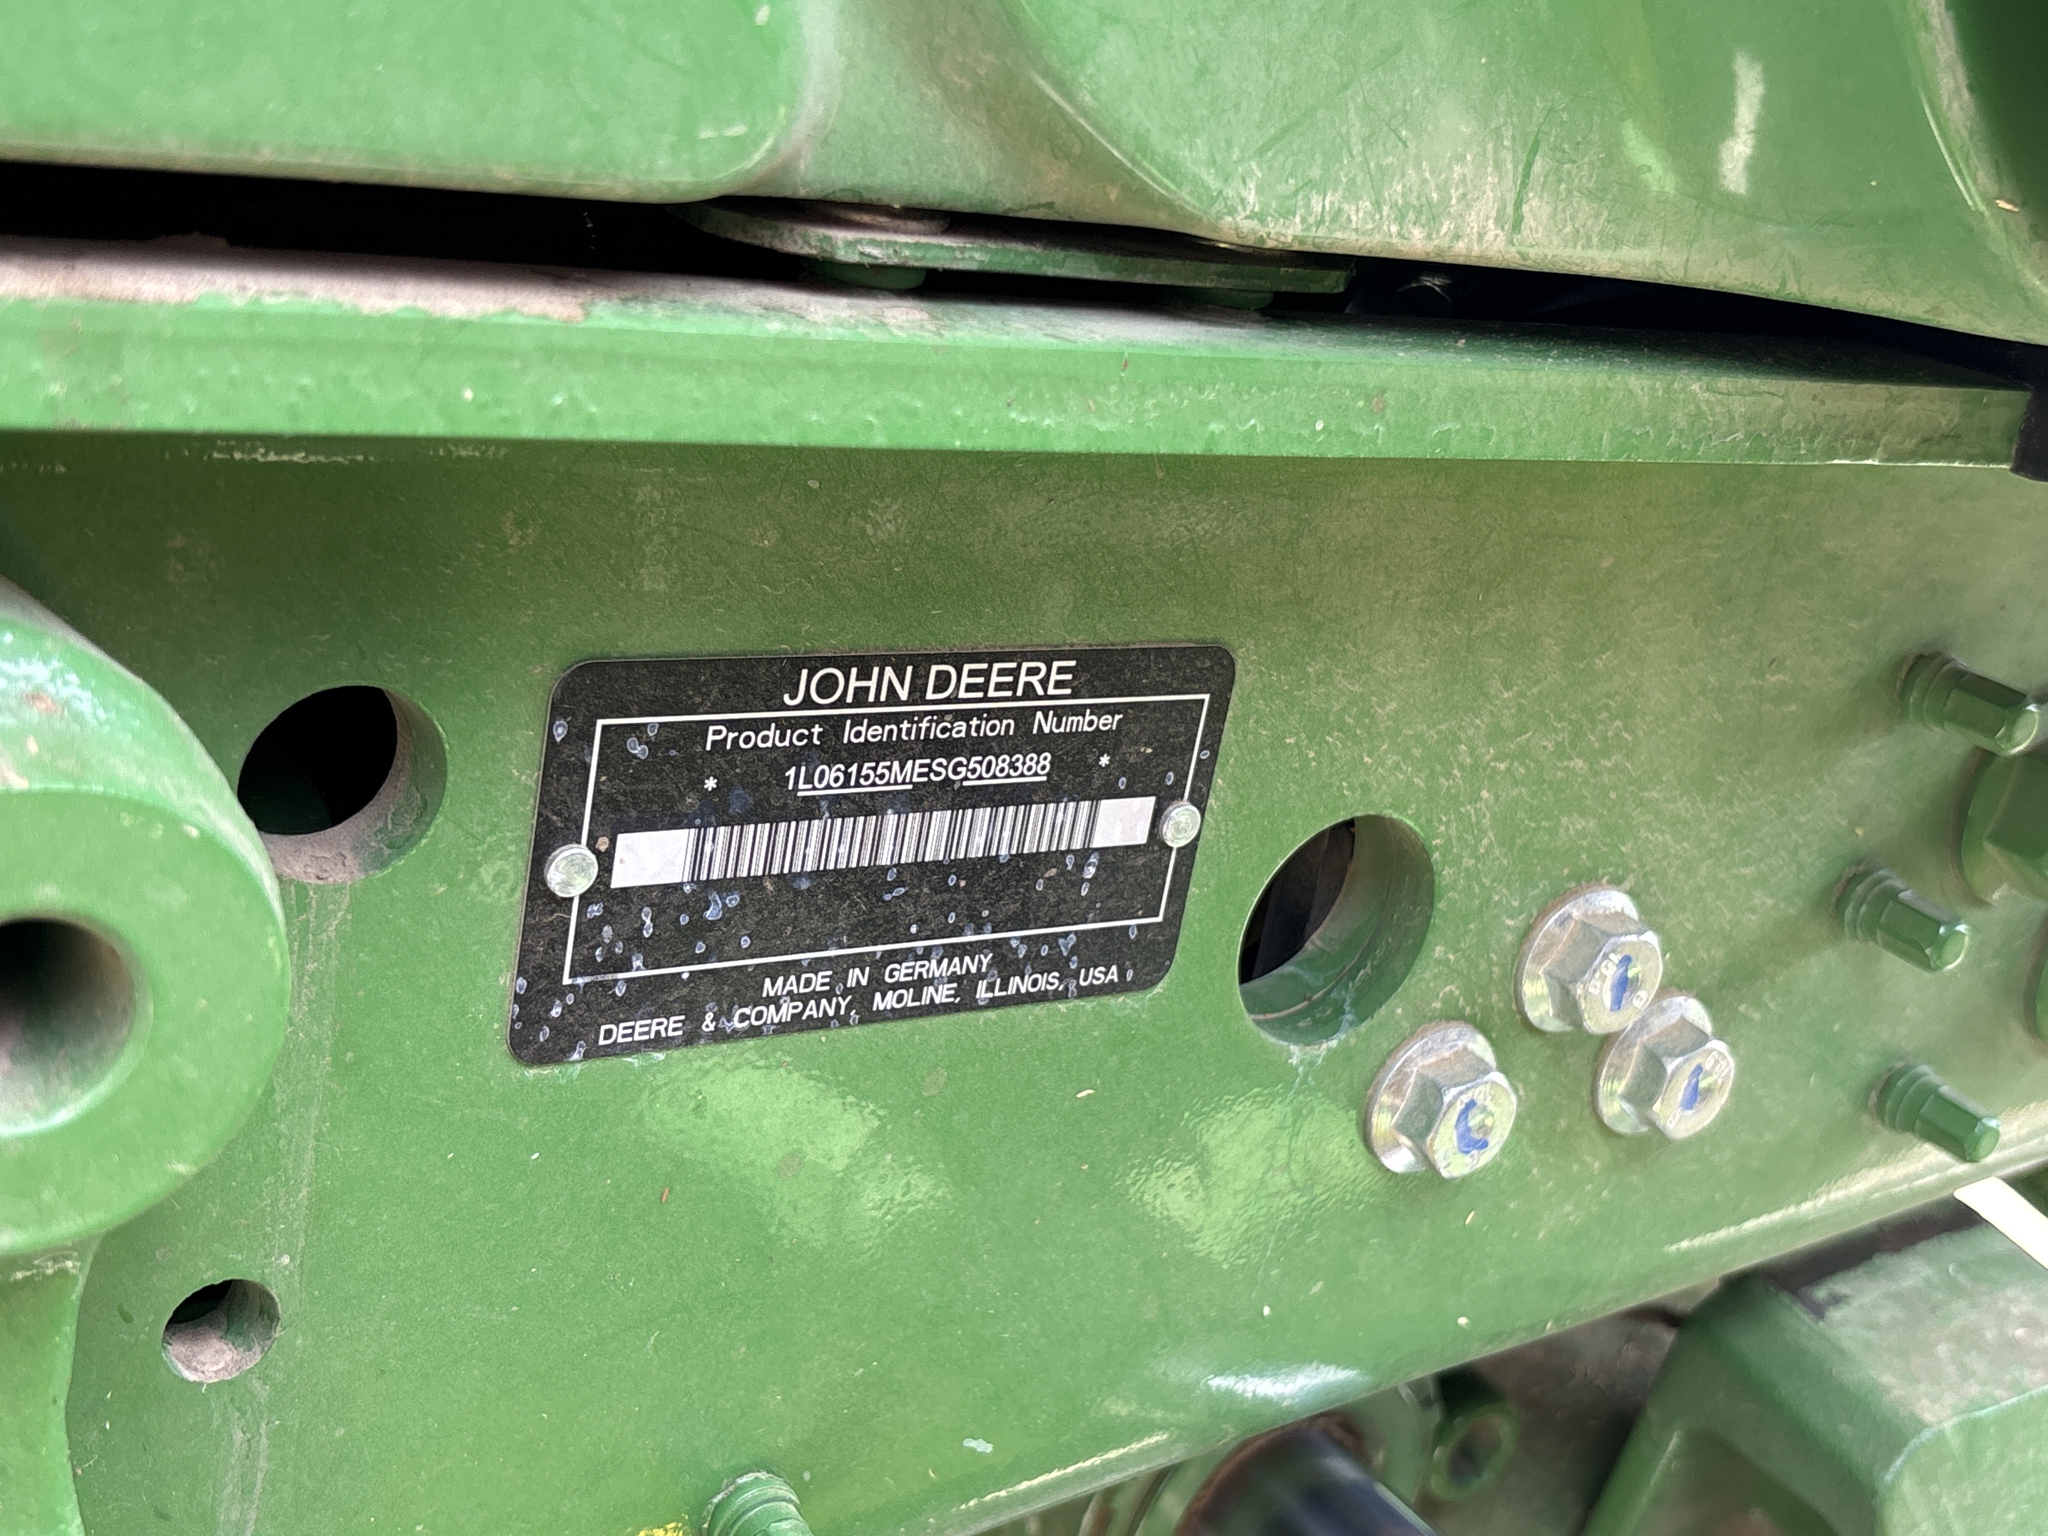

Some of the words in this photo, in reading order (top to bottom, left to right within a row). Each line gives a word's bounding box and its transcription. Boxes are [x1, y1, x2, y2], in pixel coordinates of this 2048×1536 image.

[783, 665, 914, 706] JOHN
[926, 660, 1076, 701] DEERE
[705, 722, 823, 751] Product
[843, 714, 1015, 745] Identification
[1032, 708, 1123, 735] Number
[784, 752, 1052, 792] 1L06155MESG508388
[761, 971, 832, 998] MADE
[846, 966, 869, 987] IN
[884, 953, 993, 984] GERMANY
[598, 1014, 685, 1045] DEERE
[701, 1011, 716, 1032] &
[733, 996, 857, 1029] COMPANY,
[872, 985, 961, 1012] MOLINE,
[976, 971, 1063, 1000] ILLINOIS,
[1079, 964, 1120, 986] USA
